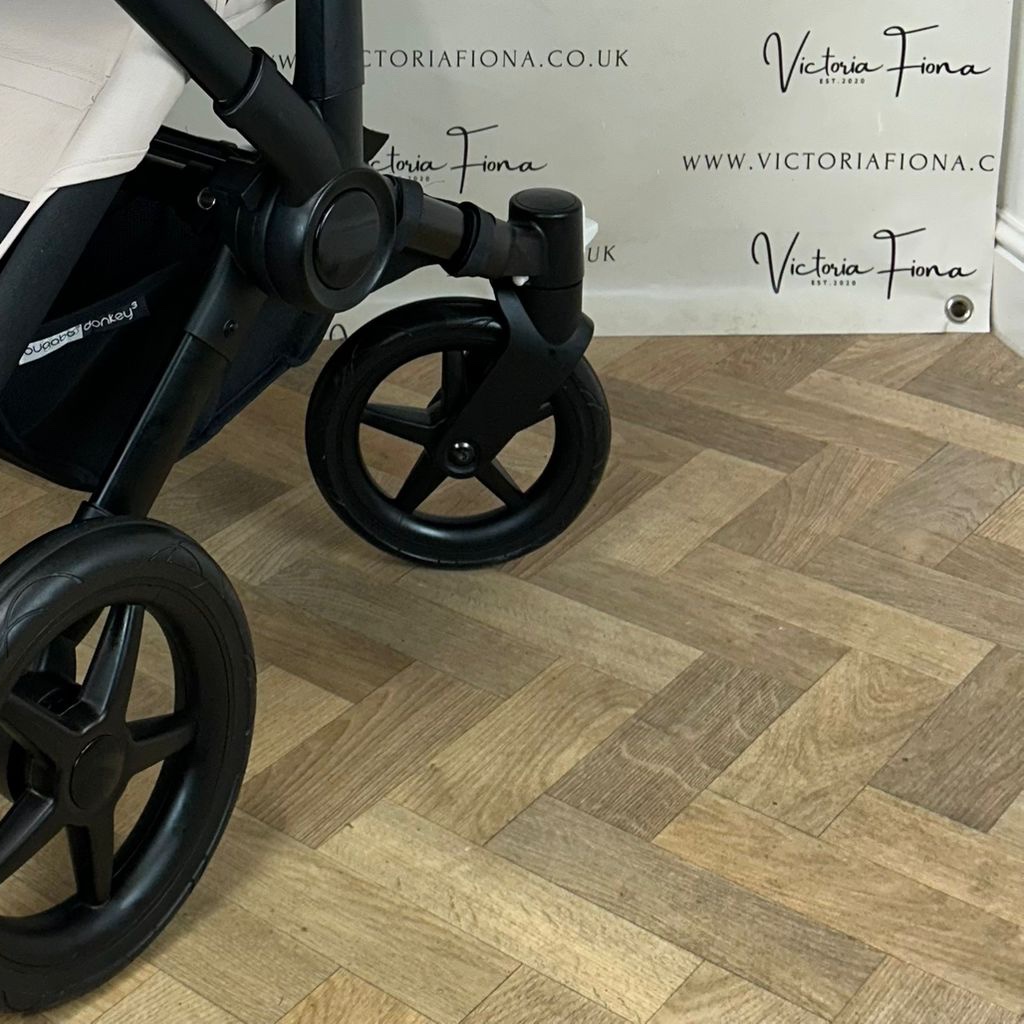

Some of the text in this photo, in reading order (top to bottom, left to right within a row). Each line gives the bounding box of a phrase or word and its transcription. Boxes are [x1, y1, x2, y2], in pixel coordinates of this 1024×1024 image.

[363, 49, 629, 67] TORIAFIONA.CO.UK
[763, 25, 991, 97] Victoria Fiona
[446, 124, 547, 194] Fiona
[751, 228, 977, 300] Victoria Fiona
